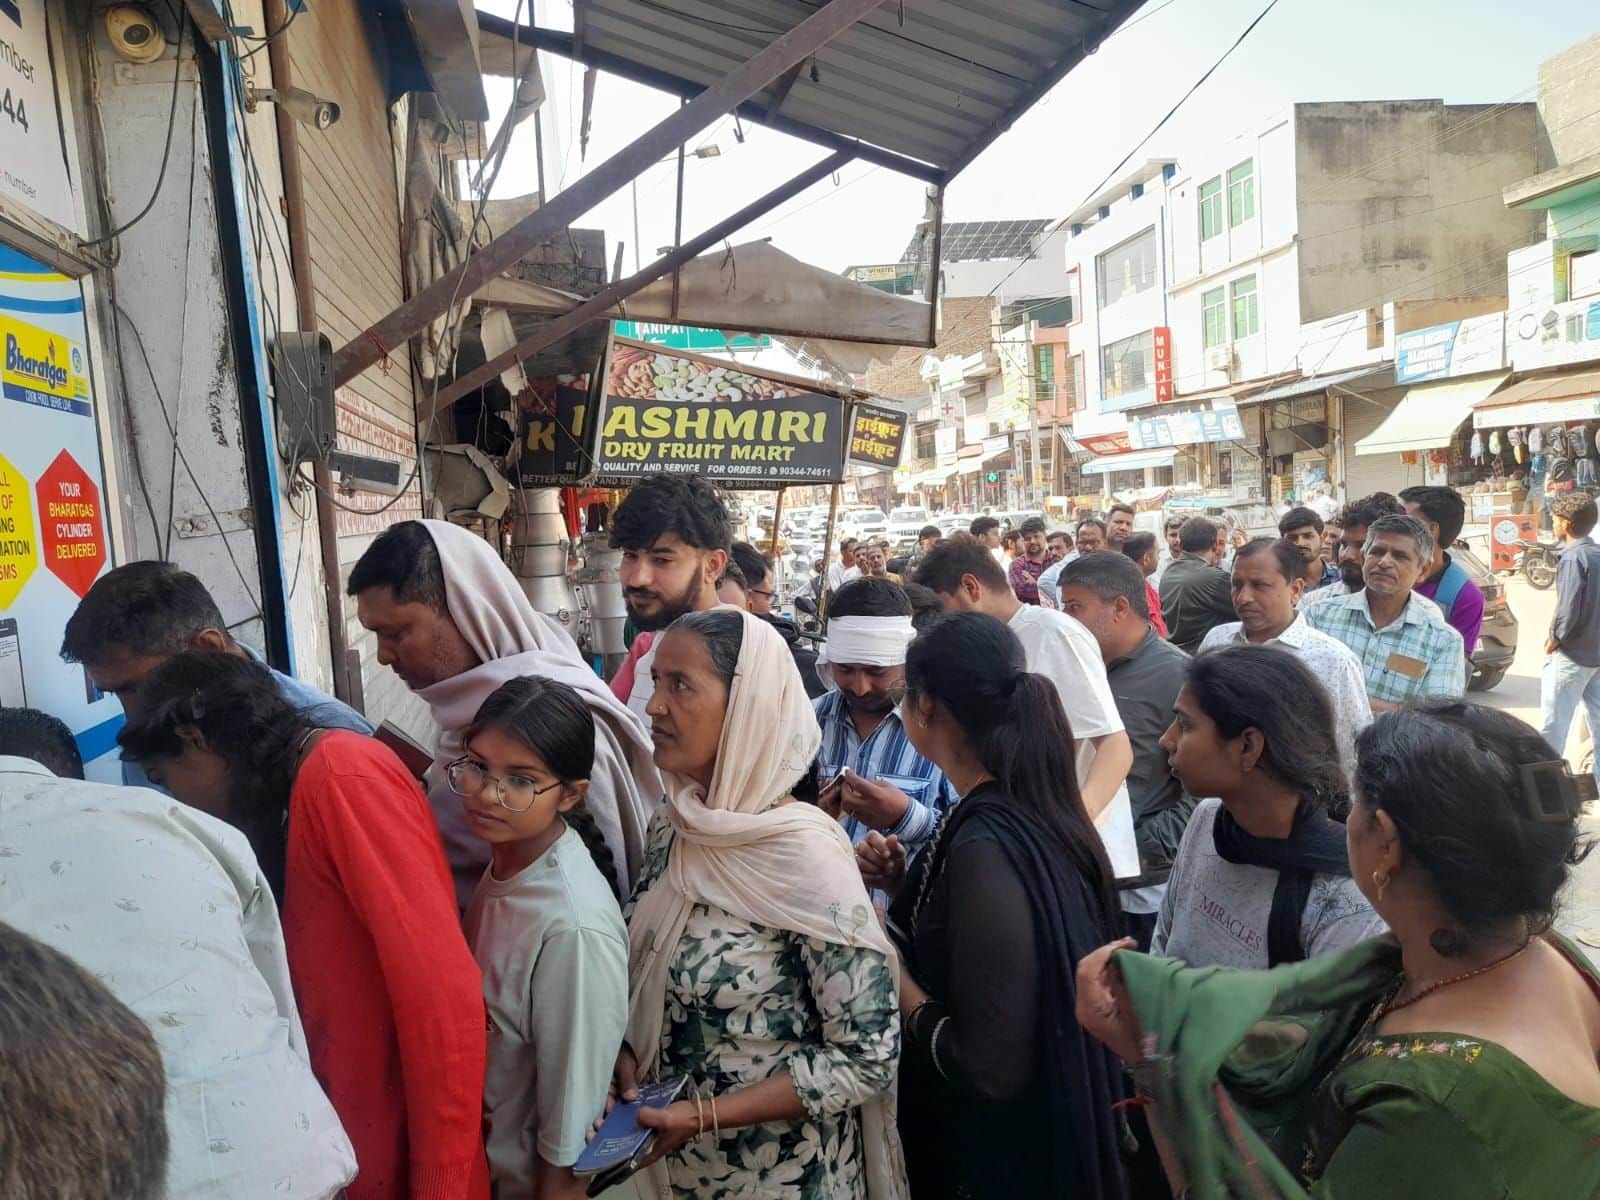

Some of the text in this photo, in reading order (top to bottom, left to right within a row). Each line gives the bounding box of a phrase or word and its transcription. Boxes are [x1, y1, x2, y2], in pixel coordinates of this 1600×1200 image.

[0, 87, 28, 133] 44
[6, 332, 67, 390] Bharatgas
[604, 441, 796, 462] DRY FRUIT MART
[602, 462, 641, 473] QUALITY
[642, 463, 662, 473] AND
[662, 463, 700, 473] SERVICE
[707, 464, 726, 474] FOR
[727, 465, 763, 475] ORDERS
[59, 482, 81, 497] YOUR
[2, 494, 14, 510] OF
[49, 502, 95, 518] BHARATGAS
[56, 523, 93, 539] CYLINDER
[56, 543, 97, 560] DELIVERED
[1199, 895, 1263, 951] MIRACLES
